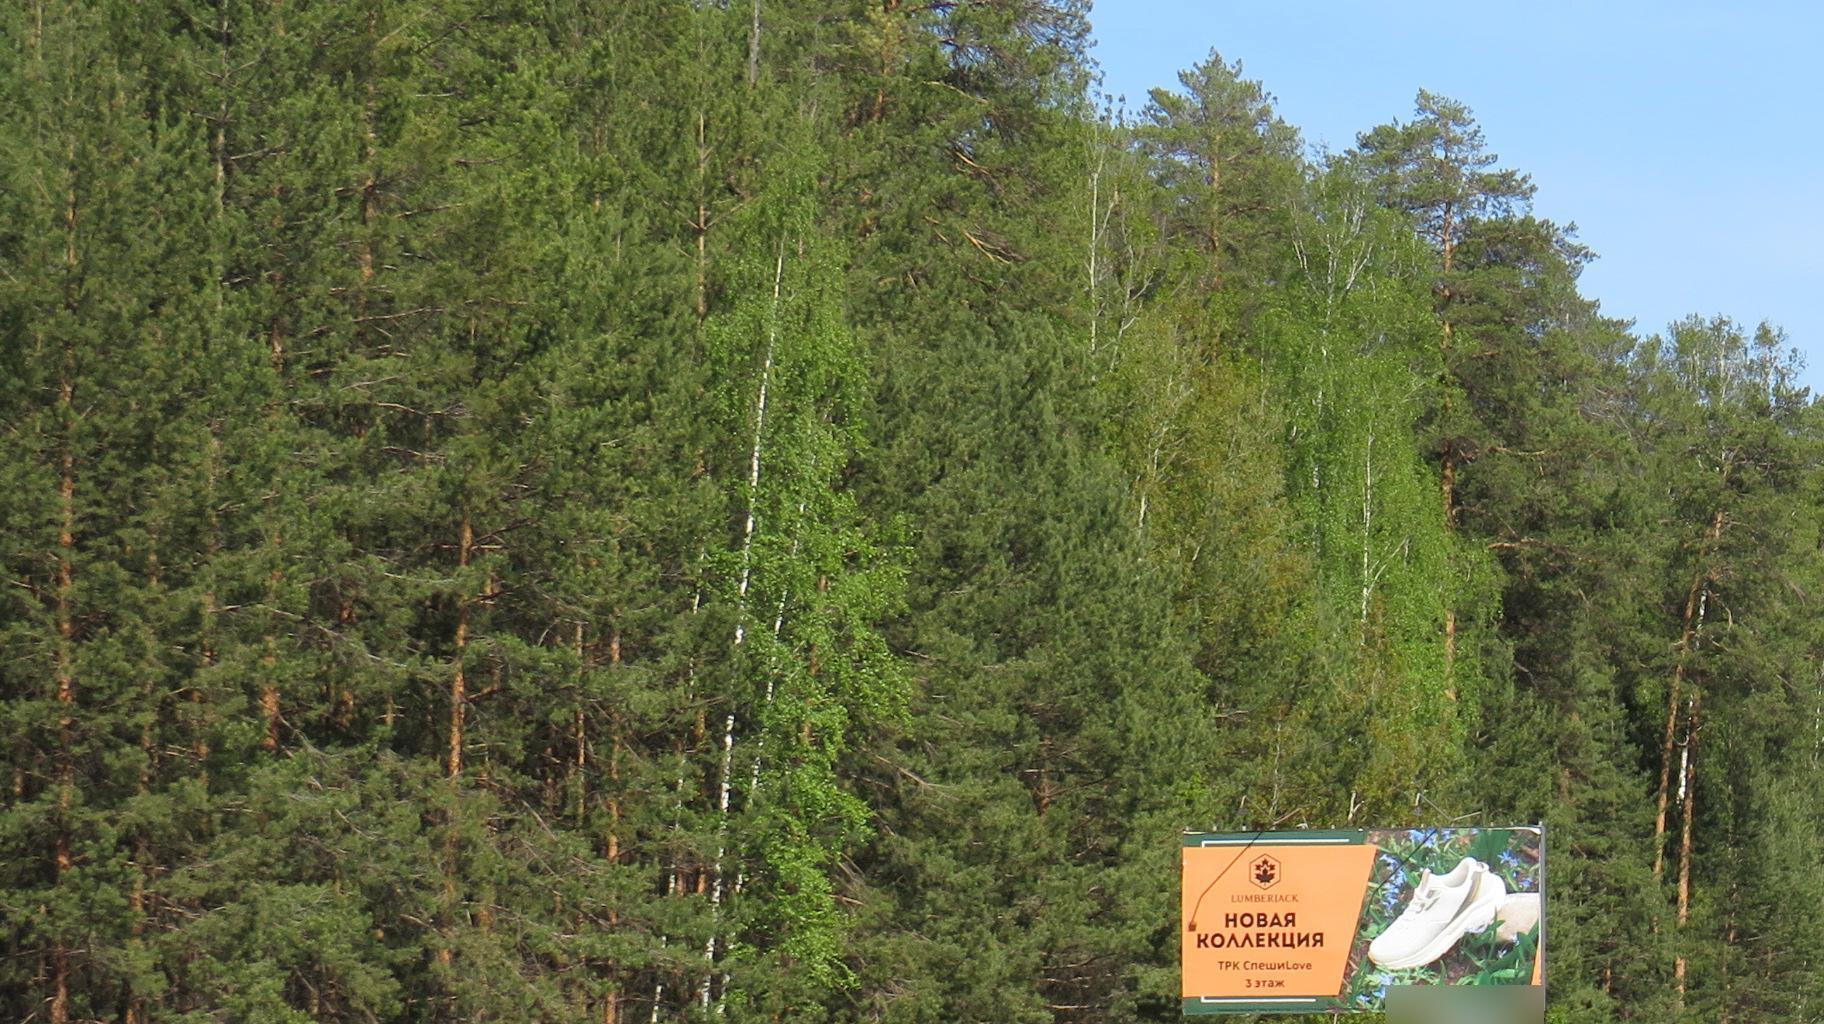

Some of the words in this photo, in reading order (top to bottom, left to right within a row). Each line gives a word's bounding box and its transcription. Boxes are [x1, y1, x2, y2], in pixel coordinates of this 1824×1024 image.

[1231, 894, 1299, 903] LUMBERJACK
[1224, 912, 1296, 928] НОВАЯ
[1196, 932, 1324, 949] КОЛЛЕКЦИЯ
[1217, 961, 1240, 971] ТРК
[1242, 960, 1313, 971] СпешиLove
[1245, 979, 1252, 988] 3
[1254, 979, 1286, 988] этаж
